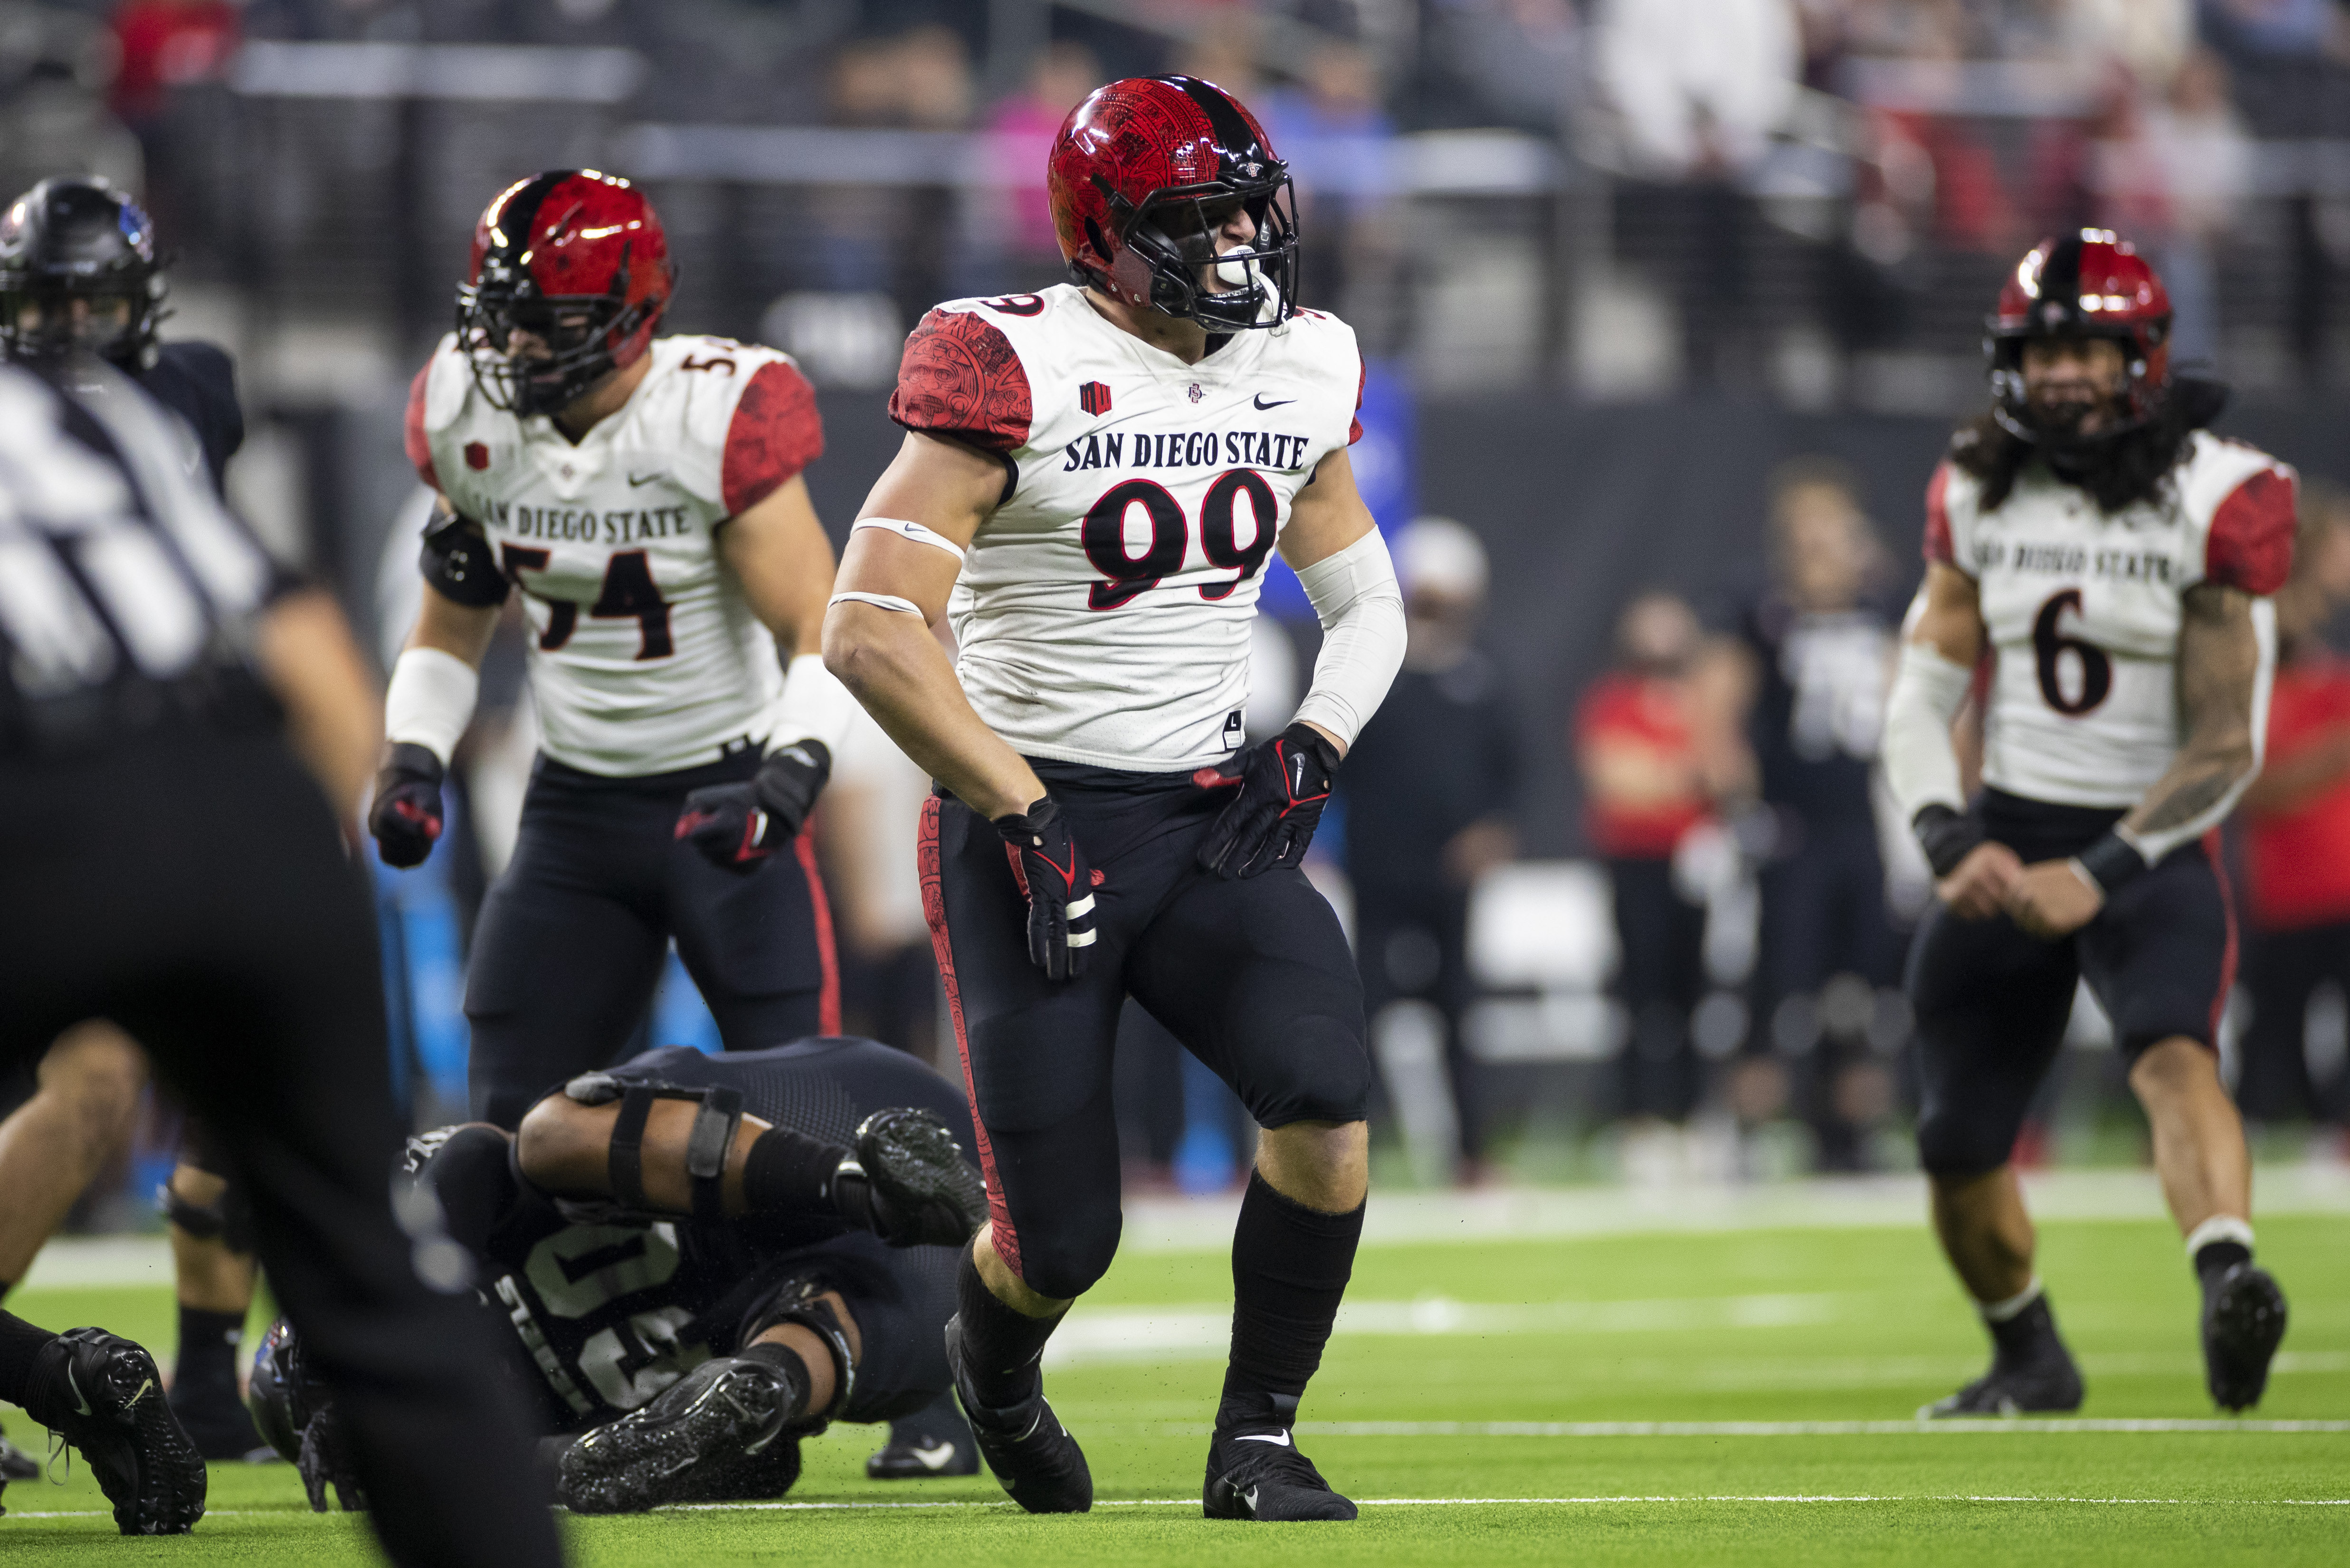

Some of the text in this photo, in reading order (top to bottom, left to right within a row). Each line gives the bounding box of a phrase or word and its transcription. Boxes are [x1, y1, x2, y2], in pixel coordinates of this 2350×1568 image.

[1063, 431, 1310, 472] SAN DIEGO STATE
[517, 504, 597, 543] DIEGO
[603, 505, 691, 544] STATE
[1081, 468, 1279, 611] 99
[501, 540, 676, 662] 54
[2033, 588, 2112, 719] 6
